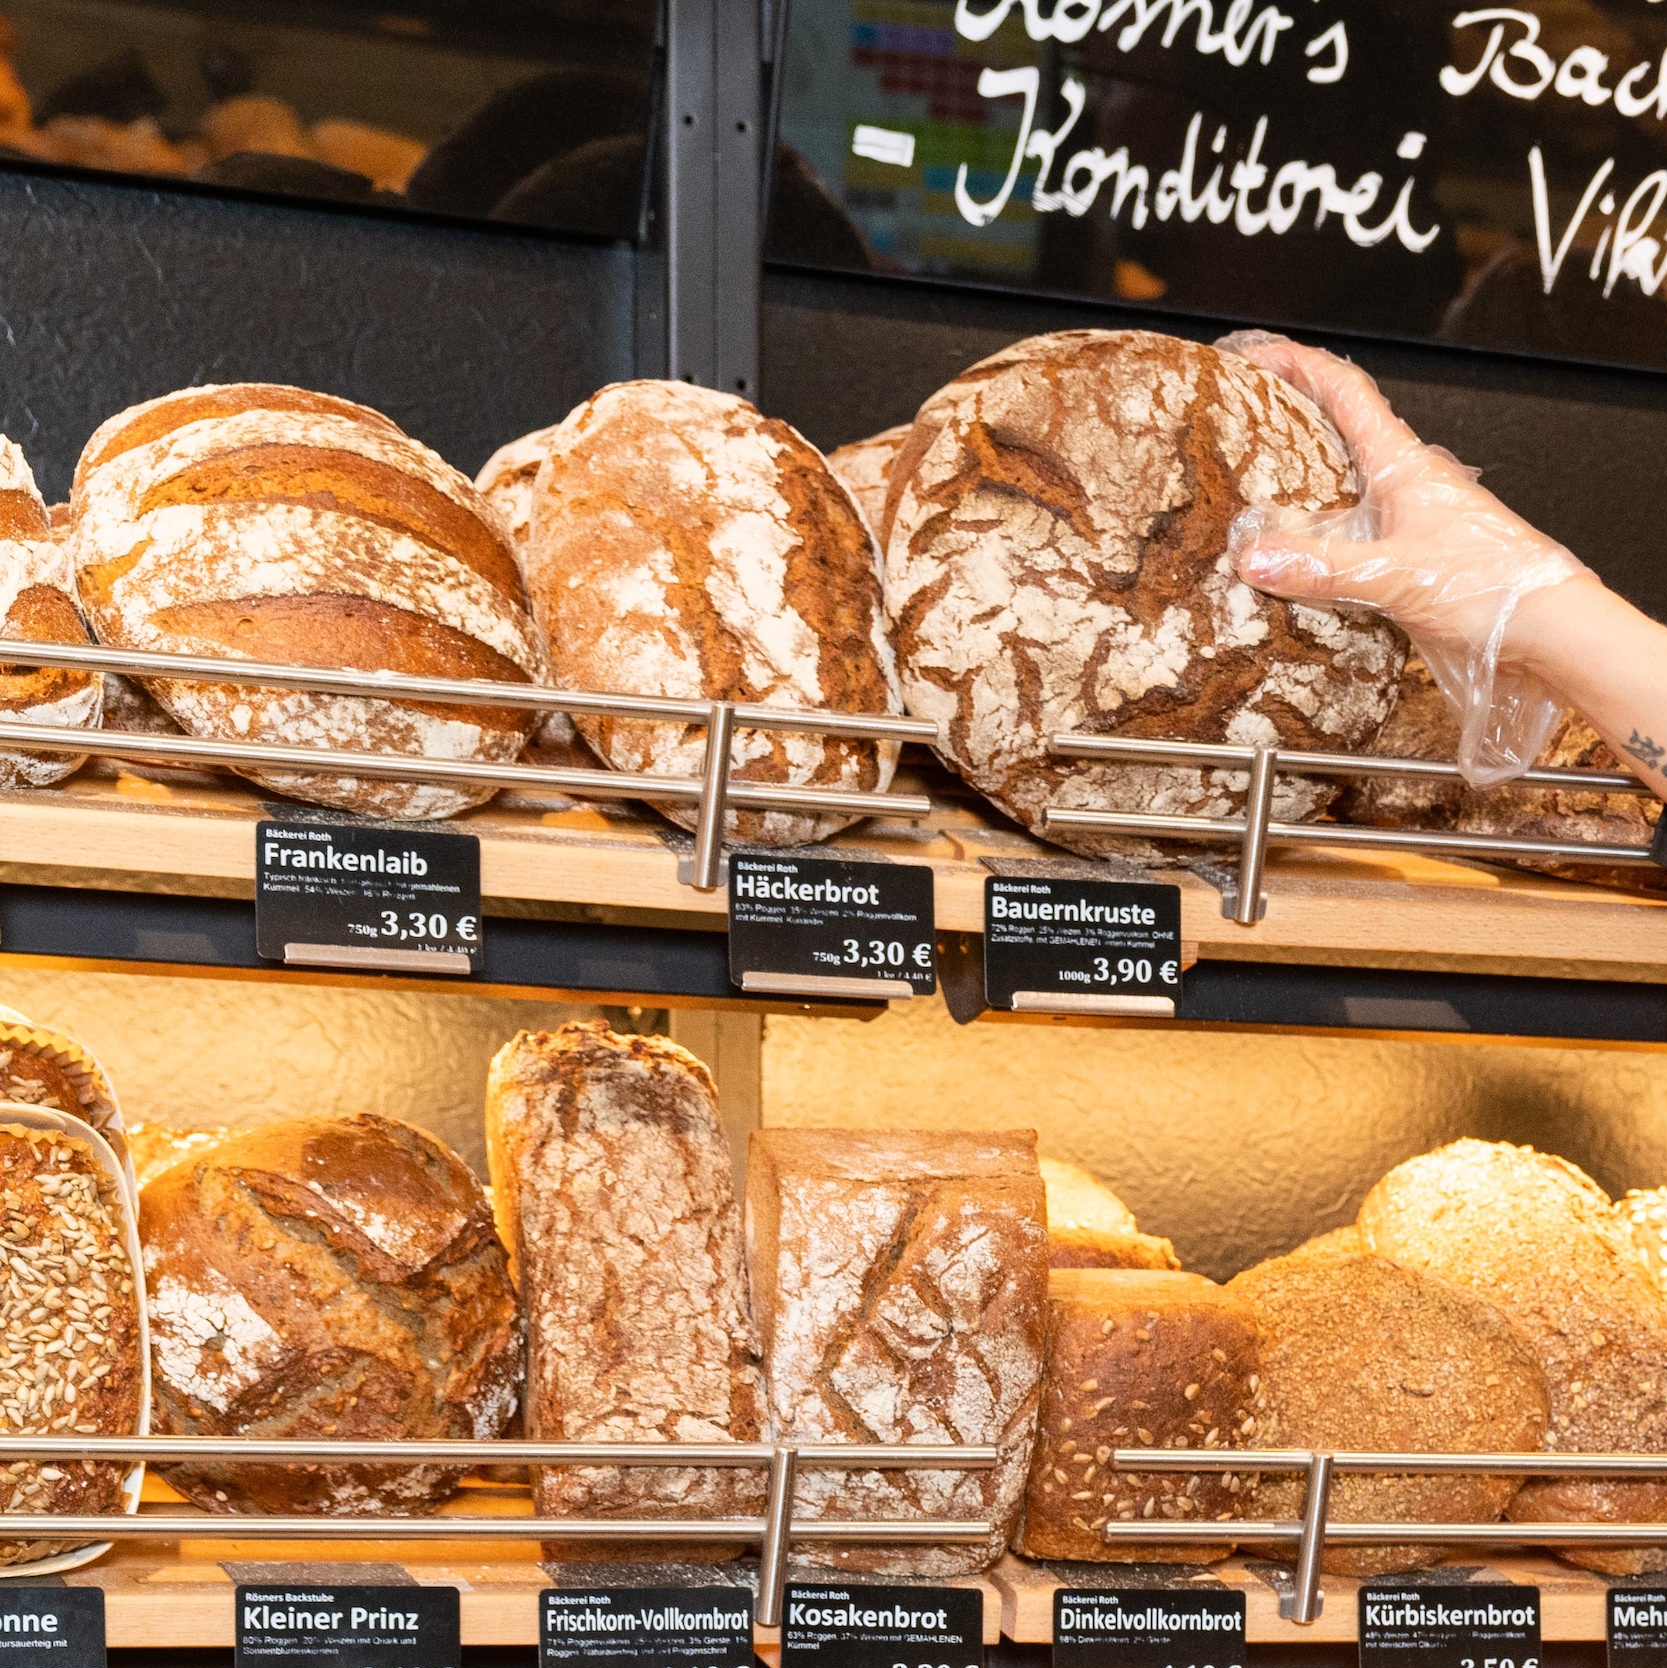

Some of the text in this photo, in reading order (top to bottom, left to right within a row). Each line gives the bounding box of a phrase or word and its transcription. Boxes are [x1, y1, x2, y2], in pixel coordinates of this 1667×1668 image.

[954, 66, 1441, 254] Konditorei
[265, 828, 332, 842] Bäckerei Roth
[263, 842, 429, 877] Frankenlaib
[737, 861, 799, 874] Bäckerei Roth
[736, 874, 880, 906] Häckerbrot
[993, 883, 1052, 894] Bäckerei Roth
[991, 896, 1156, 925] Bauernkruste
[380, 910, 449, 941] 3,30
[455, 915, 478, 941] €
[812, 939, 932, 968] 750g 3,30 €
[1058, 957, 1179, 986] 1000g 3,90 €
[245, 1592, 335, 1603] Rösners Backstube
[548, 1595, 612, 1606] Bäckerei Roth
[791, 1590, 850, 1600] Bäckerei Roth
[1062, 1595, 1119, 1604] Bäckerei Roth
[1366, 1592, 1420, 1601] Bäckerei Roth
[1647, 1594, 1666, 1603] Roth
[0, 1613, 58, 1633] nne
[243, 1606, 419, 1631] Kleiner Prinz
[546, 1606, 749, 1632] Frischkorn-Vollkornbrot
[789, 1603, 948, 1629] Kosakenbrot
[1060, 1607, 1242, 1631] Dinkelvollkornbrot
[1365, 1603, 1536, 1626] Kürbiskernbrot
[53, 1639, 68, 1648] mit
